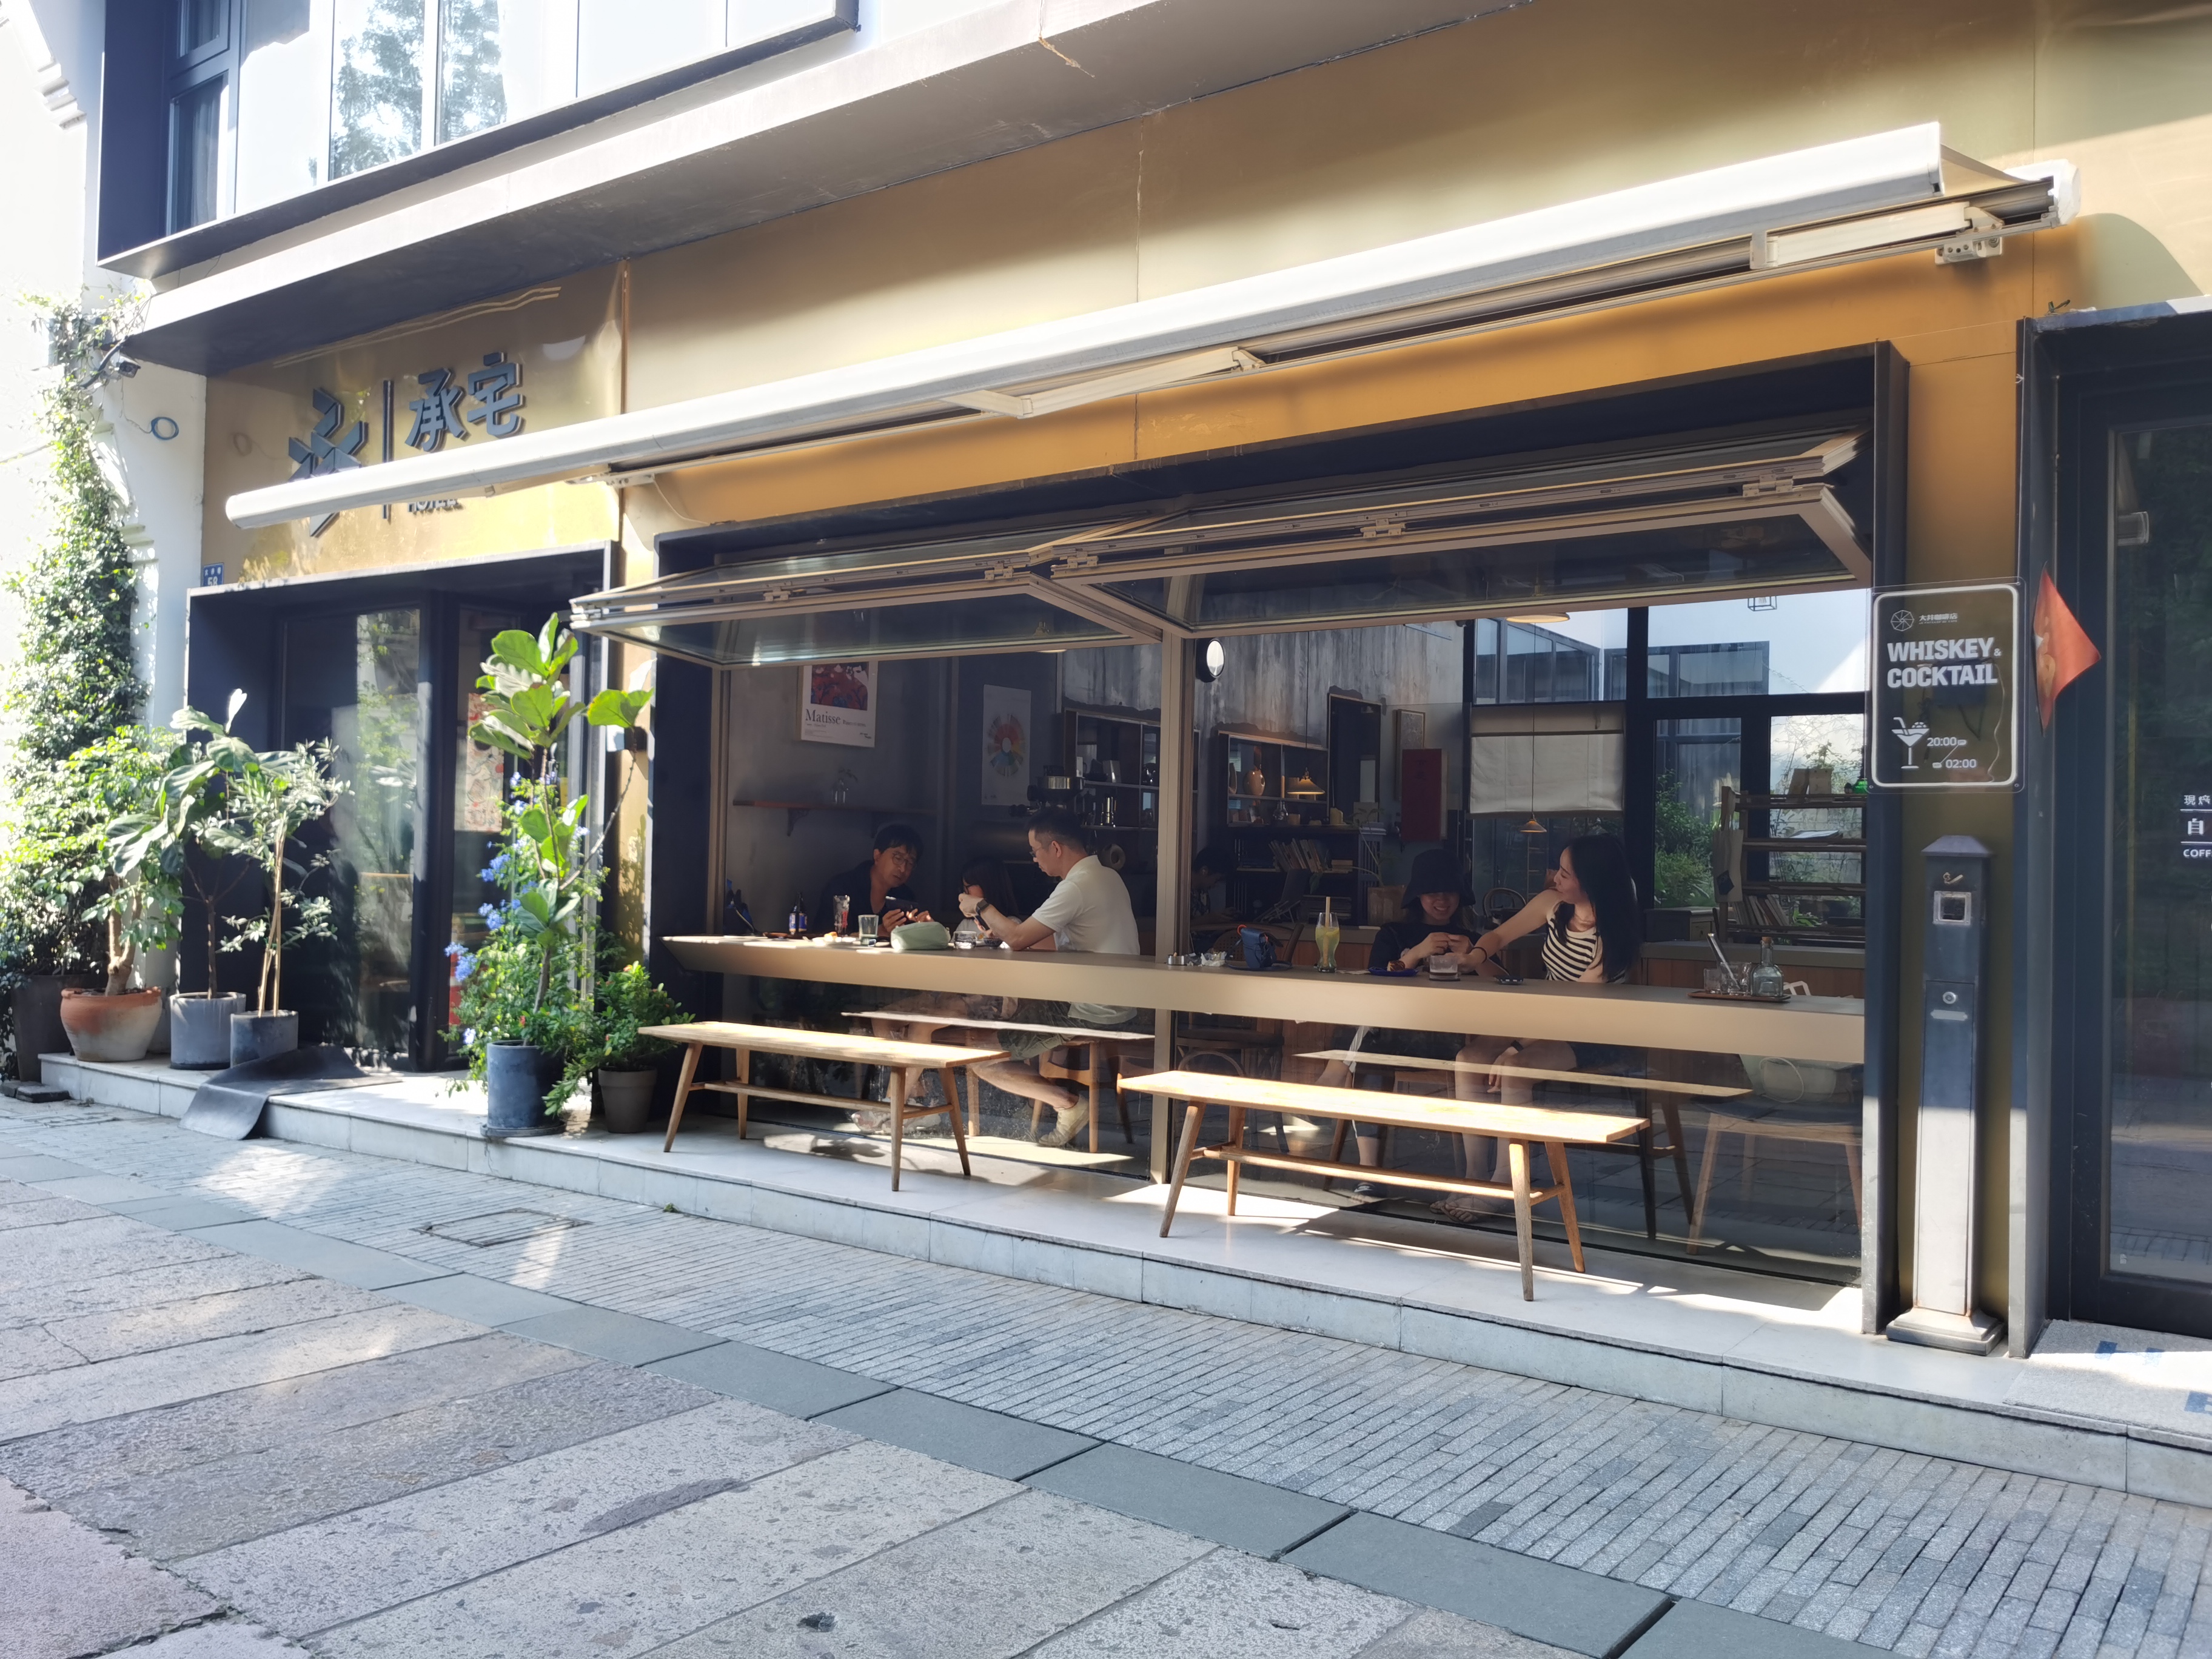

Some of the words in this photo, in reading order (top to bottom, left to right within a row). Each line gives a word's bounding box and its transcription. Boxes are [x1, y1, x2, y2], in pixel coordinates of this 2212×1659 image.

[404, 352, 523, 451] 承宅
[1887, 637, 1994, 662] WHISKEY
[1993, 648, 2002, 657] &
[1887, 663, 1998, 688] COCKTAIL
[805, 709, 840, 724] Matisse
[1927, 737, 1957, 746] 20:00
[1945, 759, 1977, 768] 02:00
[2183, 849, 2212, 857] COFF
